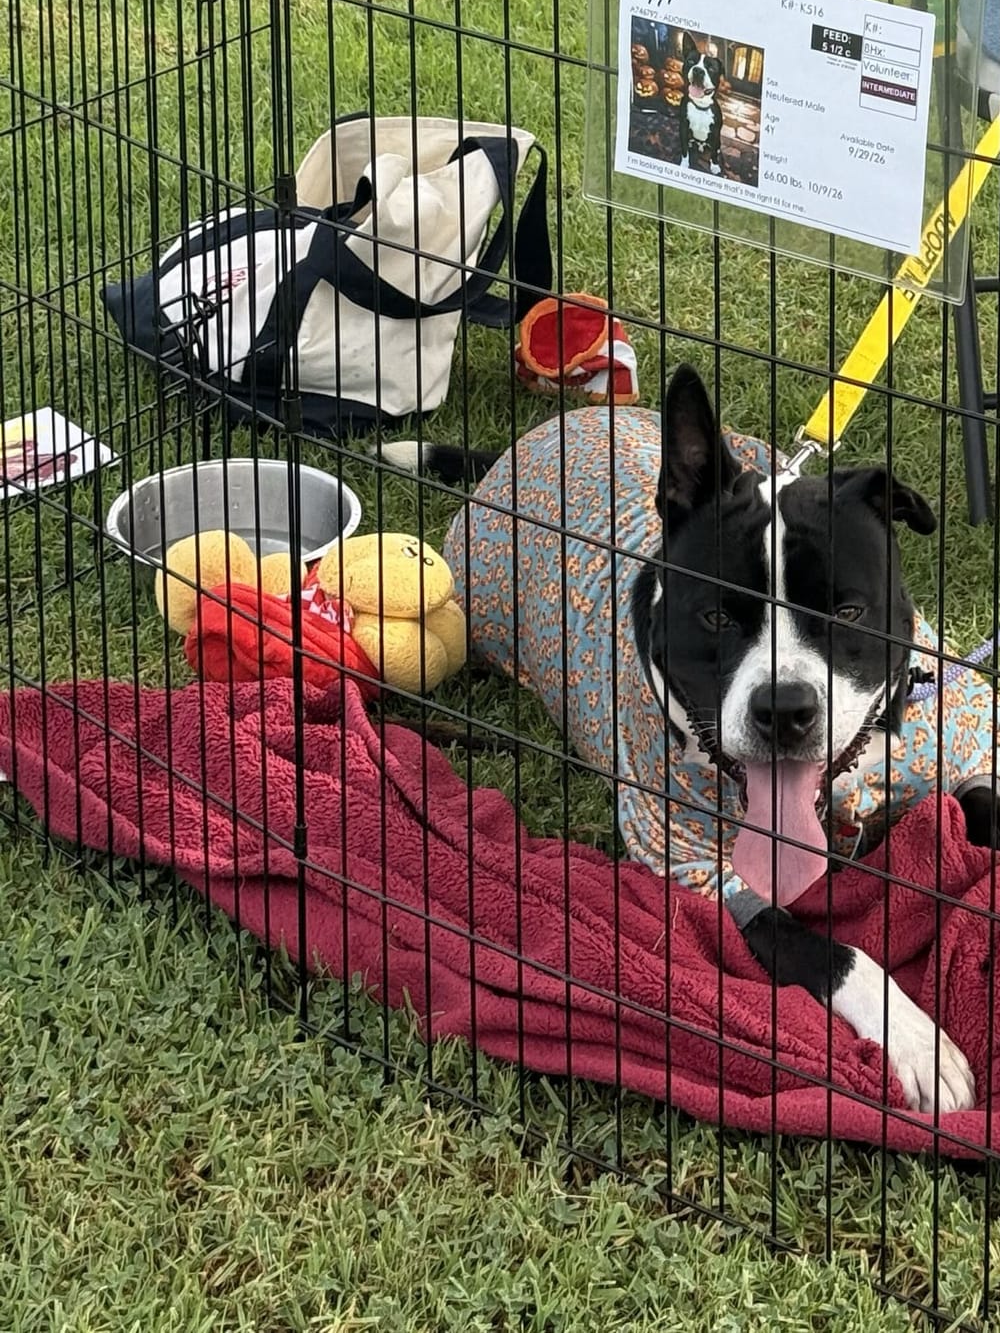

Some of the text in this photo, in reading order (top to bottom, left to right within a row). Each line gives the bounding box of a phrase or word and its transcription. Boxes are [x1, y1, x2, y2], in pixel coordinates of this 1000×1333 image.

[800, 4, 824, 18] K516
[823, 28, 852, 45] FEED:
[865, 21, 882, 35] K#:
[822, 42, 828, 52] 5
[830, 44, 843, 57] 1/2
[862, 80, 916, 102] INTERMEDIATE
[765, 90, 826, 113] Neutered Male
[765, 113, 780, 123] Age
[840, 132, 895, 154] Available Date
[763, 151, 788, 164] Weight
[848, 146, 886, 165] 9/29/26
[639, 158, 664, 174] looking
[664, 167, 674, 175] for
[681, 171, 702, 184] loving
[703, 177, 723, 189] home
[745, 188, 756, 198] the
[757, 193, 773, 203] right
[782, 199, 791, 208] for
[764, 170, 788, 185] 66.00
[808, 180, 843, 201] 10/9/26
[911, 210, 956, 275] ADOPT
